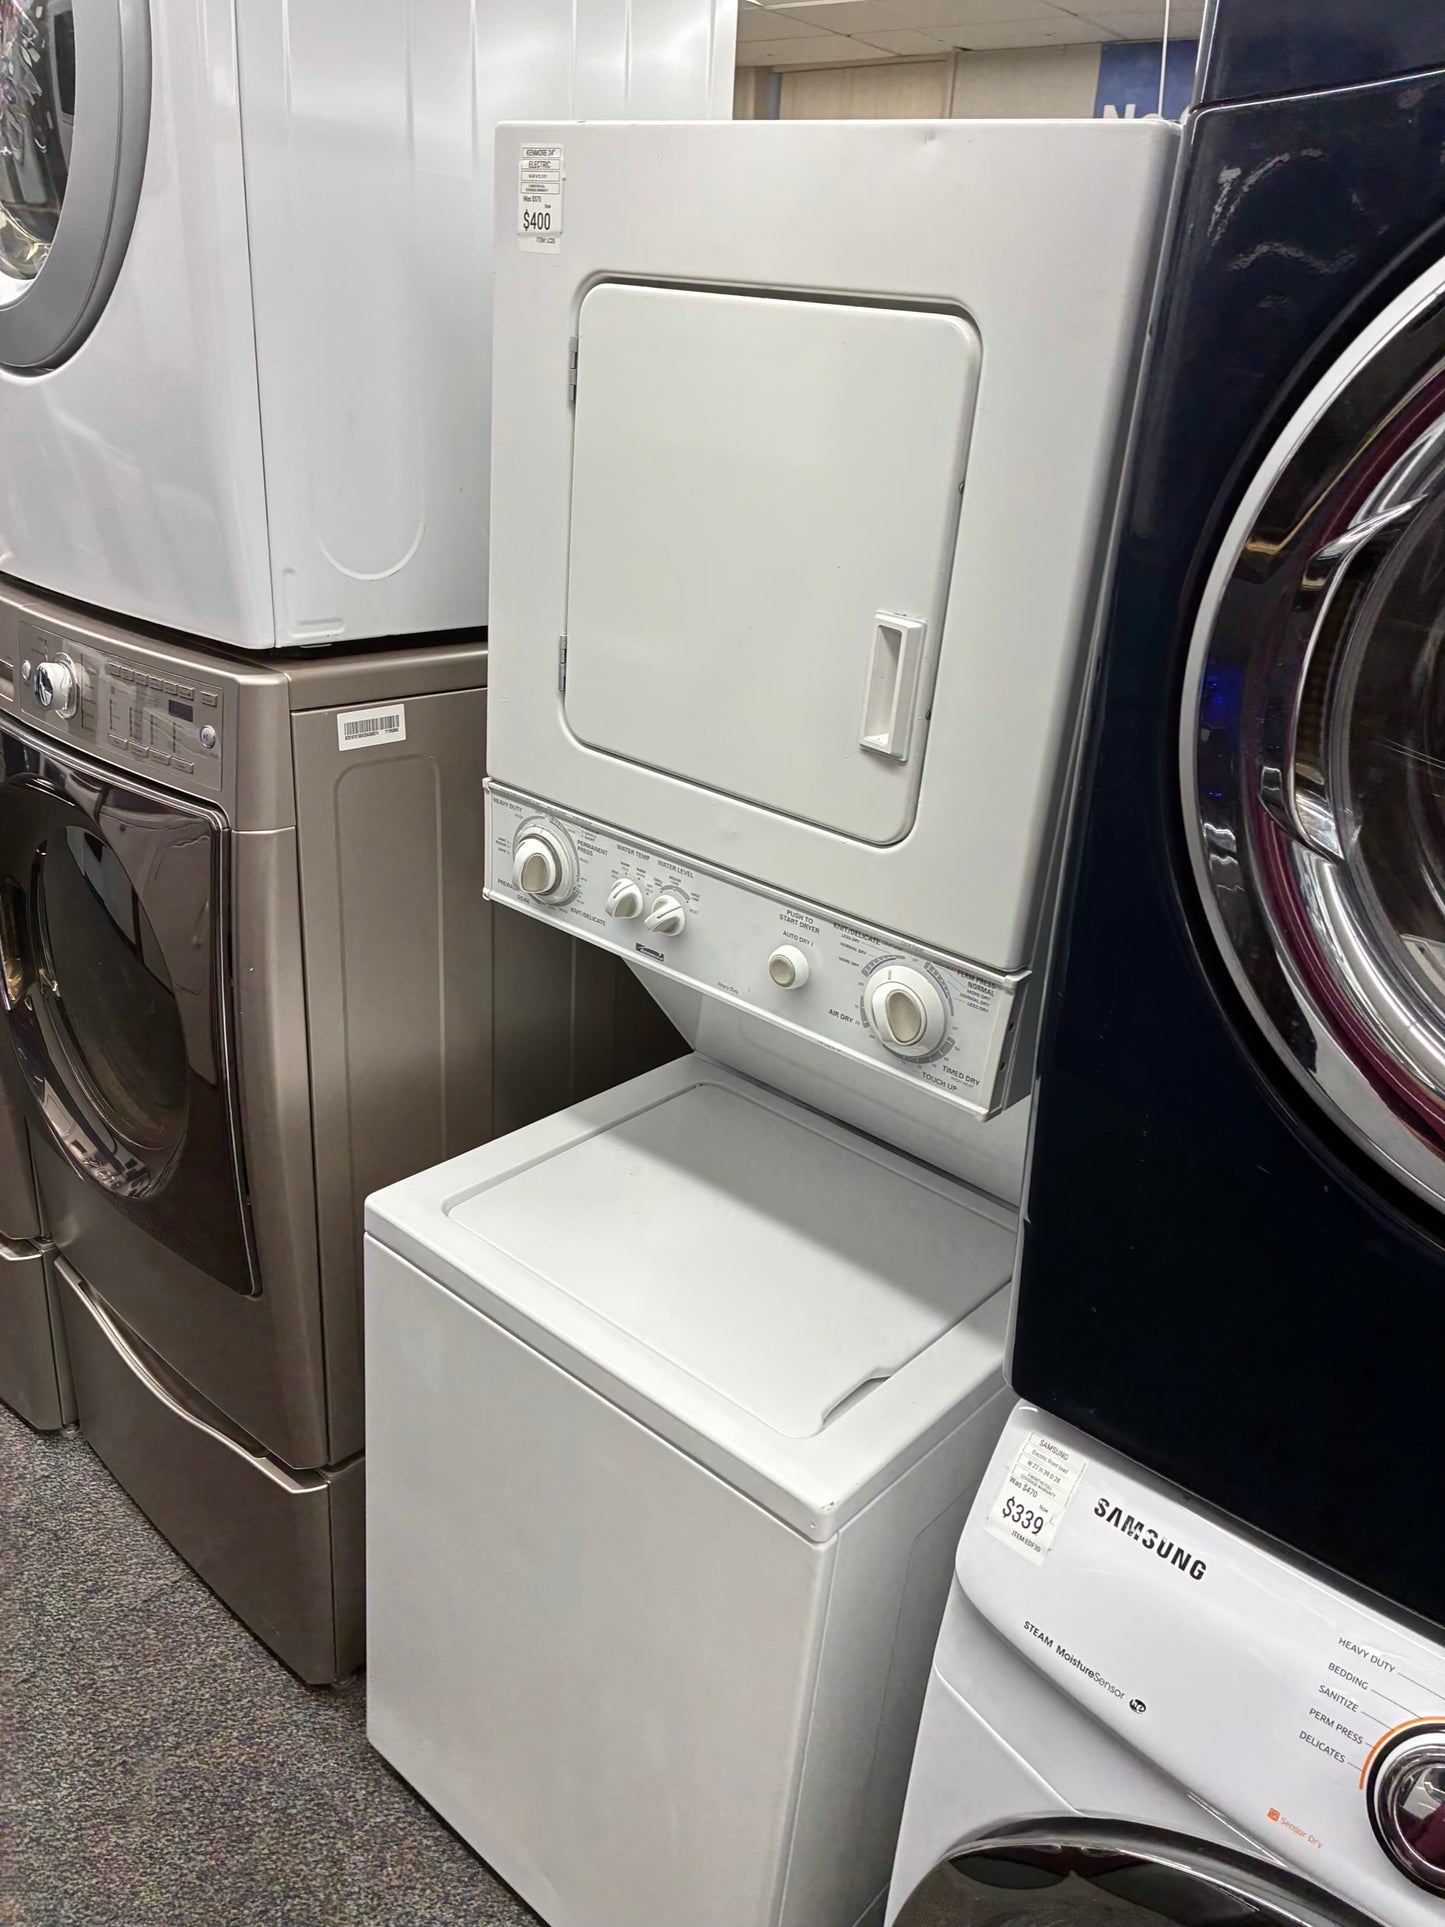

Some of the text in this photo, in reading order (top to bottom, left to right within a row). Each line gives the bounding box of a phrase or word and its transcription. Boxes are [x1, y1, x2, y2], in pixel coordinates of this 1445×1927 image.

[529, 161, 551, 169] ELECTRIC
[523, 208, 551, 231] $400
[509, 804, 522, 812] DUTY
[577, 839, 608, 856] PERMANENT
[577, 846, 593, 857] PRESS
[616, 843, 650, 861] WATER TEMP
[658, 860, 677, 872] WATER
[677, 867, 694, 879] LEVEL
[779, 914, 820, 935] START DRYER
[786, 909, 814, 925] PUSH TO
[782, 930, 799, 941] AUTO
[799, 937, 810, 946] DRY
[833, 922, 881, 945] KNIT/DELICATE
[956, 969, 996, 989] PERM PRESS
[967, 982, 995, 997] NORMAL
[828, 1008, 840, 1018] AIR
[840, 1013, 854, 1024] DRY
[922, 1071, 958, 1092] TOUCH UP
[942, 1064, 980, 1087] TIMED DRY
[1039, 1439, 1070, 1461] SAMSUNG
[1009, 1475, 1038, 1498] Was $470
[1002, 1496, 1044, 1535] $339
[1094, 1497, 1207, 1581] SAMSUNG
[1023, 1620, 1054, 1648] STEAM
[1055, 1644, 1126, 1699] MoistureSensor
[1338, 1636, 1396, 1673] HEAVY DUTY
[1327, 1662, 1369, 1691] BEDDING
[1318, 1684, 1360, 1713] SANITIZE
[1308, 1707, 1364, 1745] PERM PRESS
[1298, 1730, 1346, 1763] DELICATES
[1280, 1816, 1323, 1849] Sensor Dry
